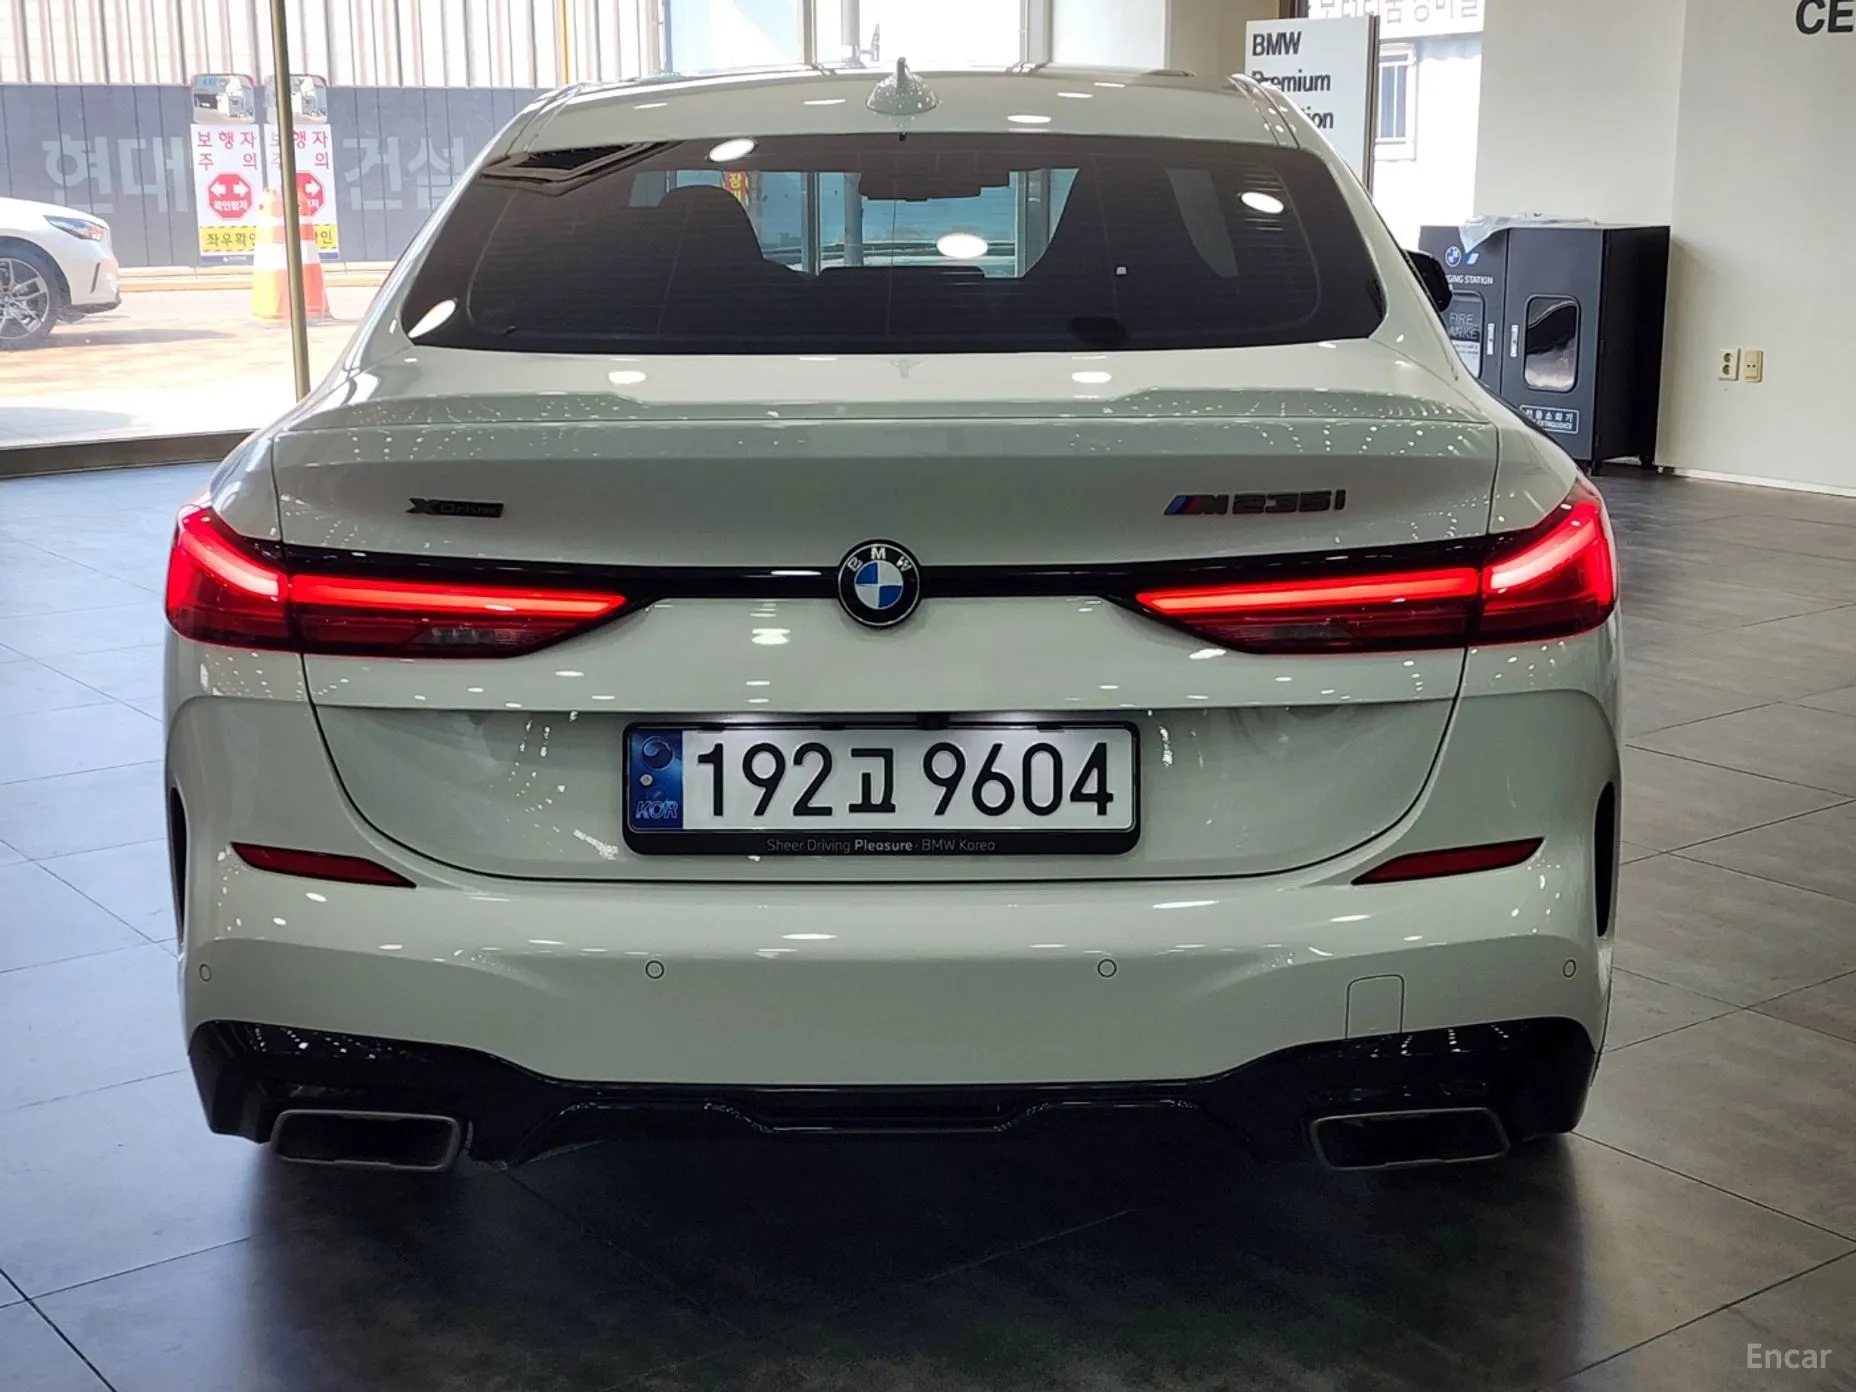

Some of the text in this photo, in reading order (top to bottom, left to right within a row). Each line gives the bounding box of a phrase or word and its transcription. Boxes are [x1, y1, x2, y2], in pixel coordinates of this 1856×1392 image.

[1252, 31, 1302, 56] BMW
[198, 131, 256, 149] 보행자
[1450, 312, 1474, 325] FIRE
[847, 547, 912, 572] BMW
[697, 742, 1114, 817] 192고 9604
[635, 800, 678, 820] KOR
[767, 838, 996, 854] Sheer Driving Pleasure BMW Korea
